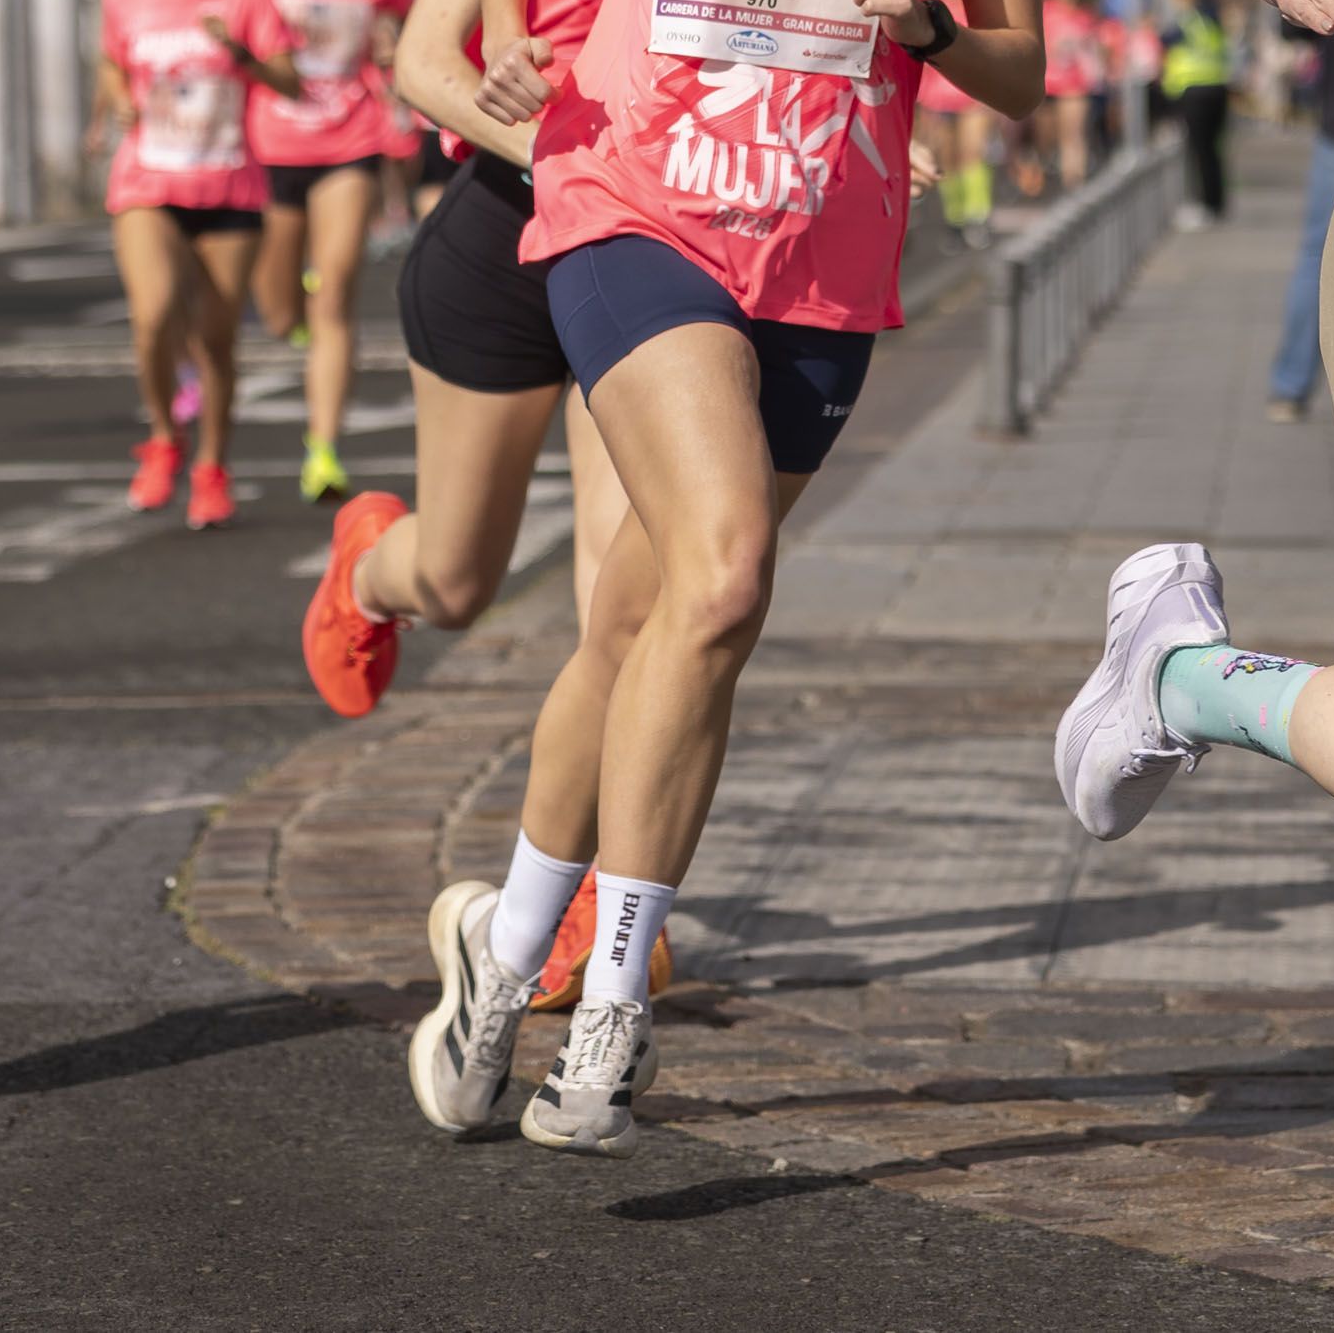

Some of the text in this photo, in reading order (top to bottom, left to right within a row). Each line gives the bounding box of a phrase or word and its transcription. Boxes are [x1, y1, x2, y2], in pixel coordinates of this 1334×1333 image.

[660, 1, 864, 39] CARRERA DE LA MUJER GRAN CANARIA
[666, 31, 701, 44] OYSHO
[662, 130, 830, 216] MUJER
